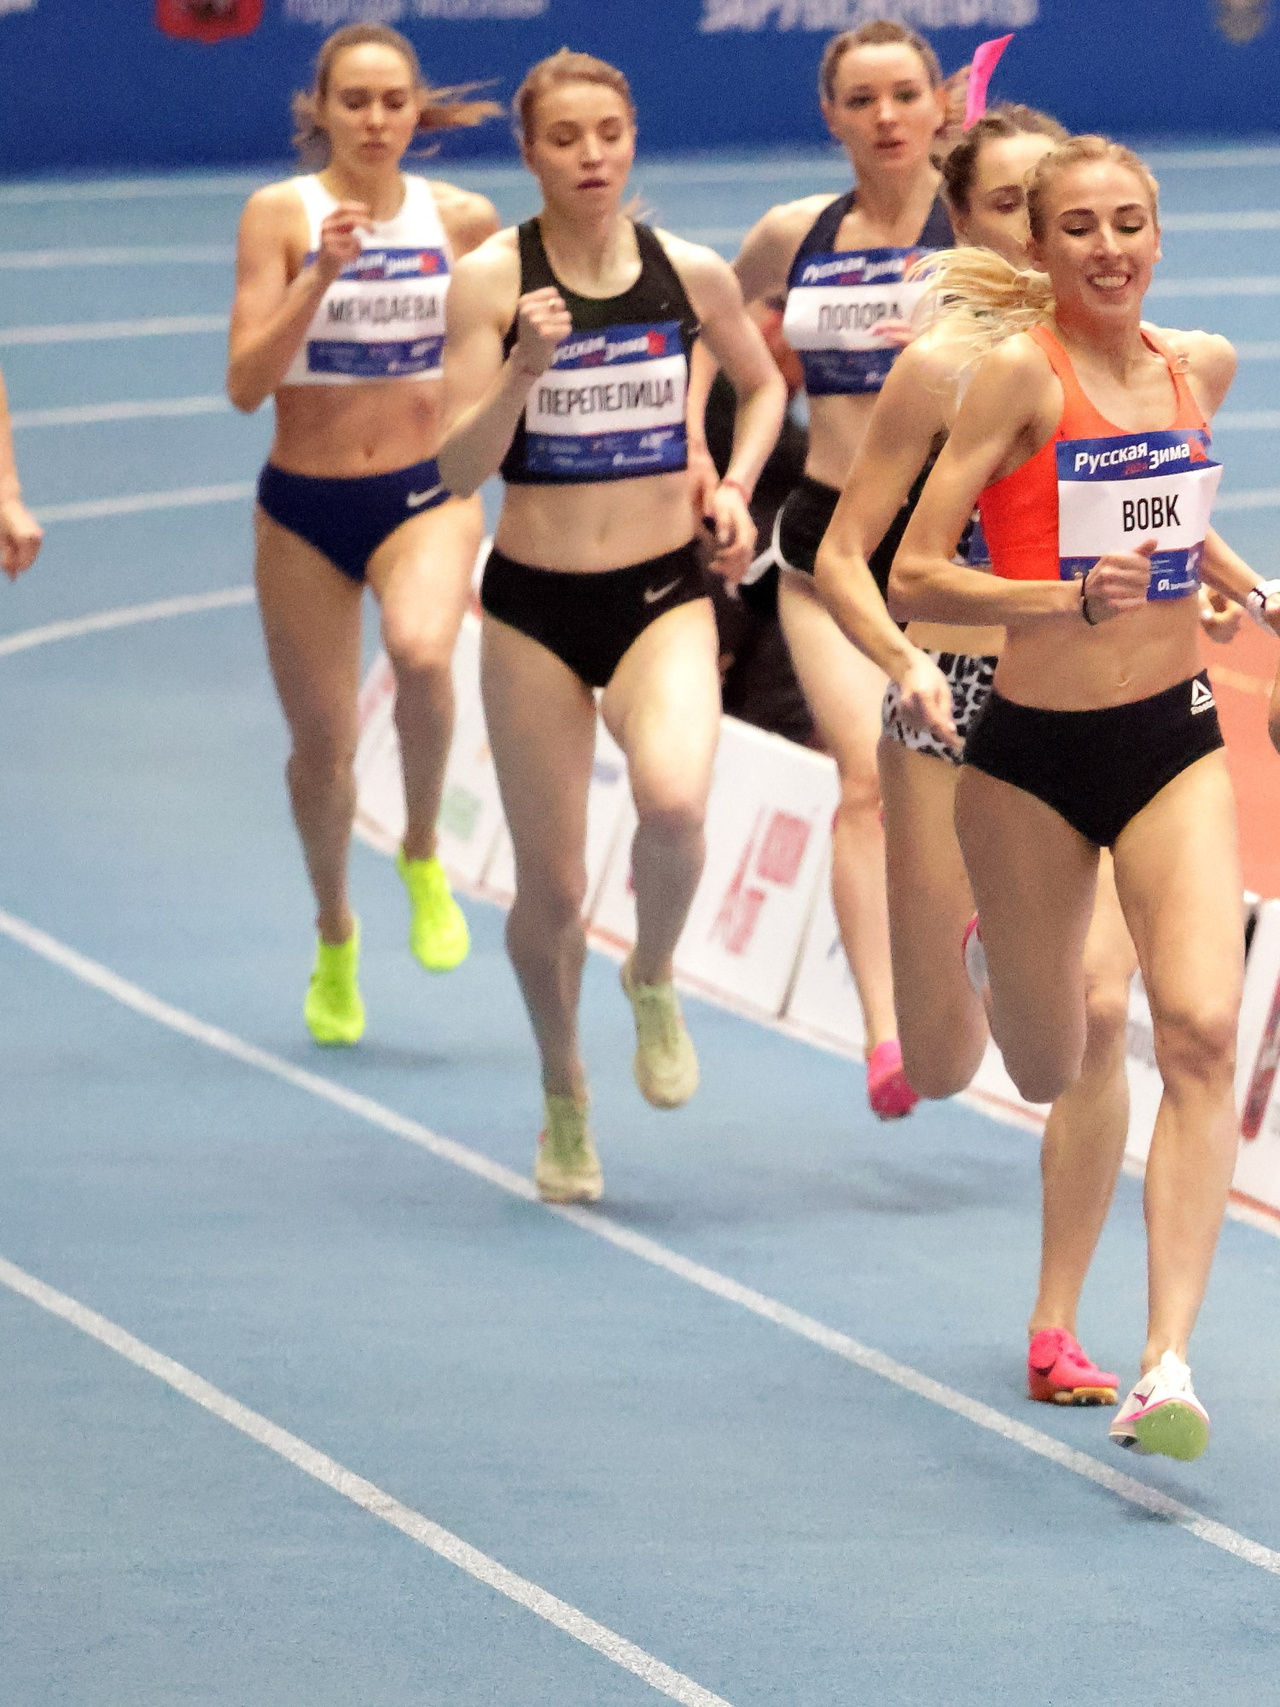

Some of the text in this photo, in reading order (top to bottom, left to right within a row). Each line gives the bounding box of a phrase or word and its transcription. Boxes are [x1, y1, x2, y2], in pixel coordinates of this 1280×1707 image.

[538, 378, 676, 416] ПЕРЕПЕЛИЦА
[1074, 441, 1191, 475] Русская Зима
[1122, 494, 1181, 532] ВОВК
